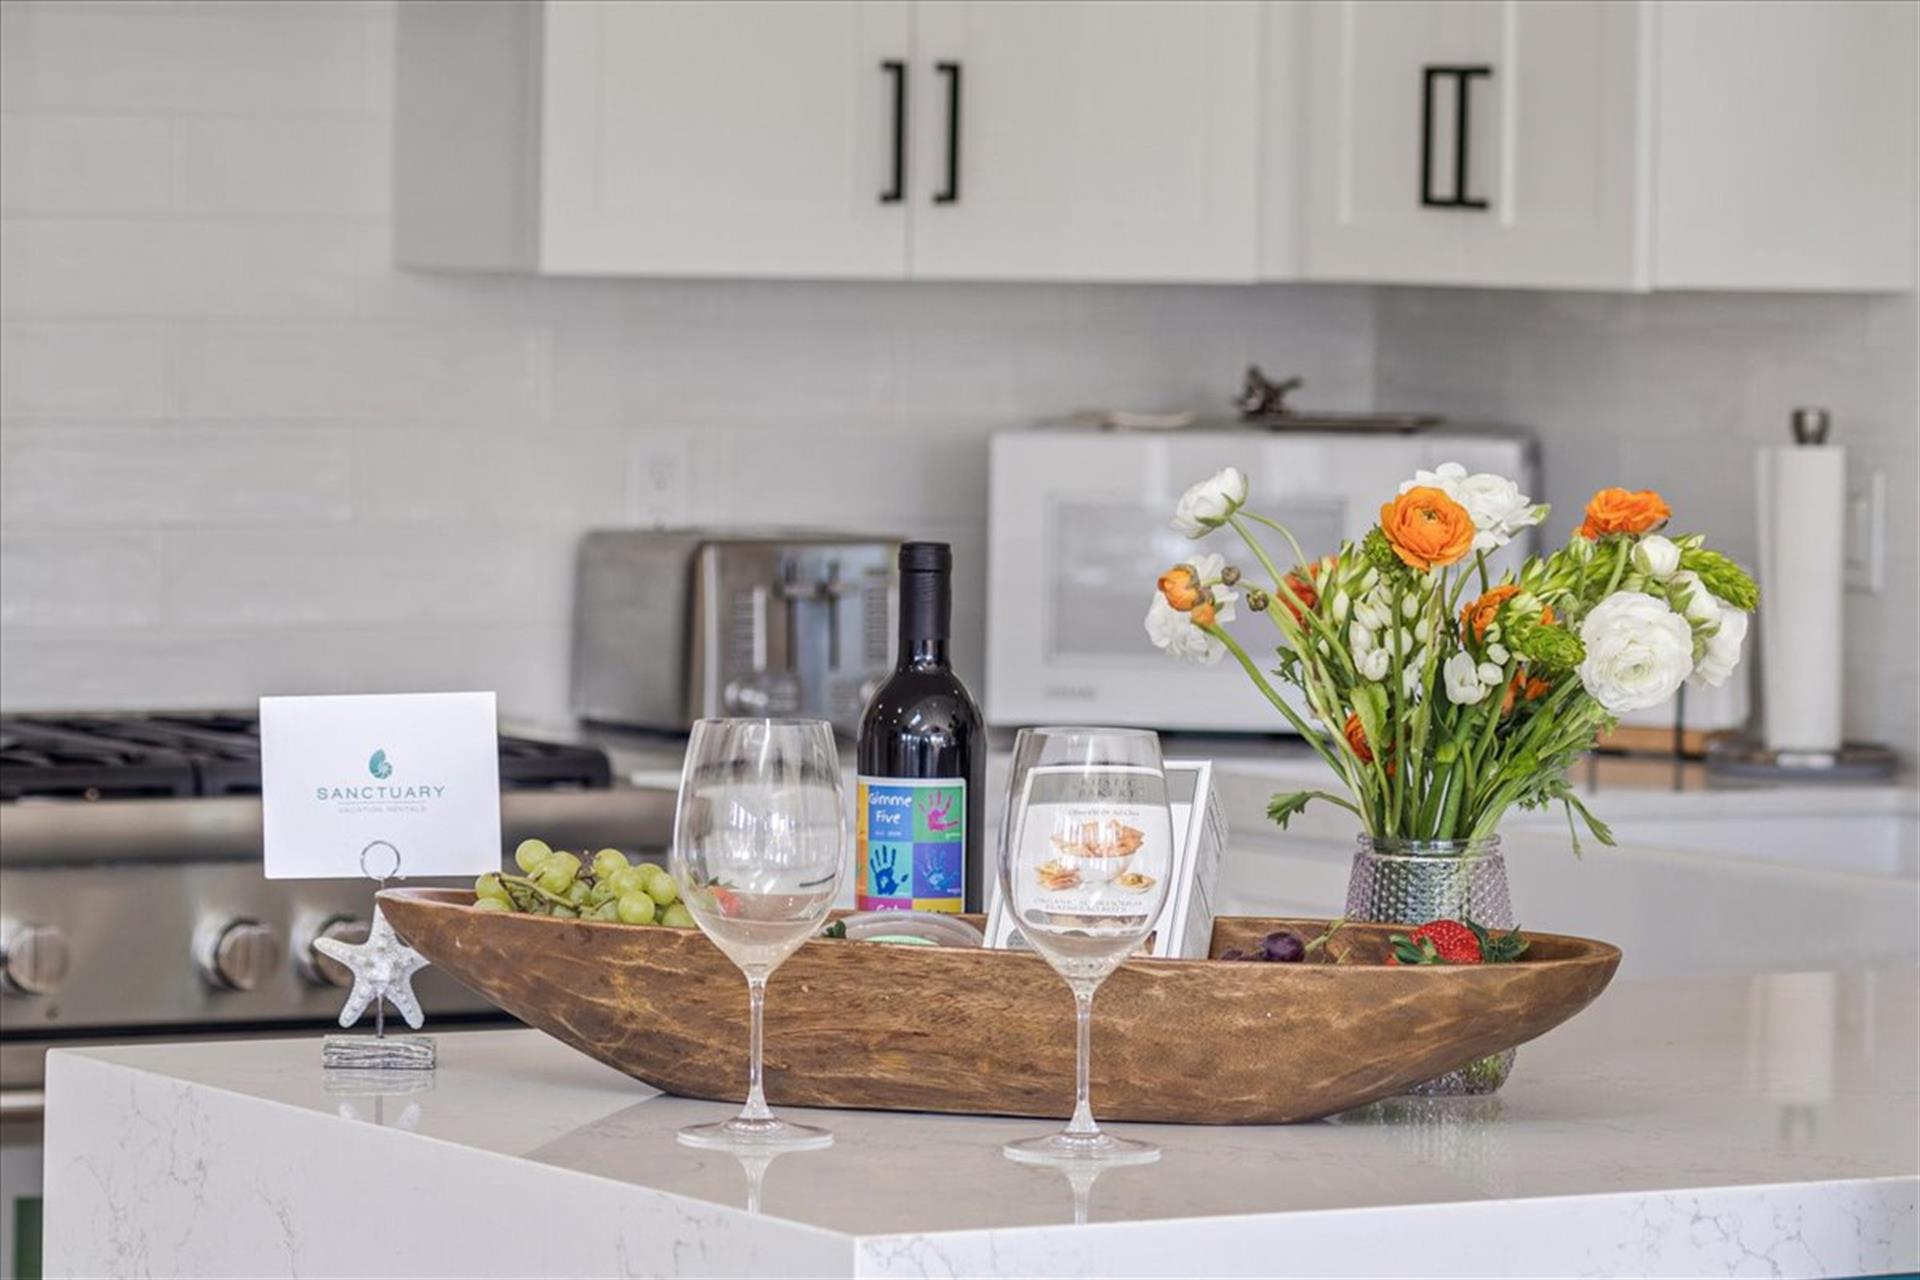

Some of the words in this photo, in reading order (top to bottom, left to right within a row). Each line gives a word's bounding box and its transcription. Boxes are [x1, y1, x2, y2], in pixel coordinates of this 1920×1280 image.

[316, 785, 446, 801] SANCTUARY
[868, 790, 913, 808] Gimme
[875, 808, 902, 825] Five
